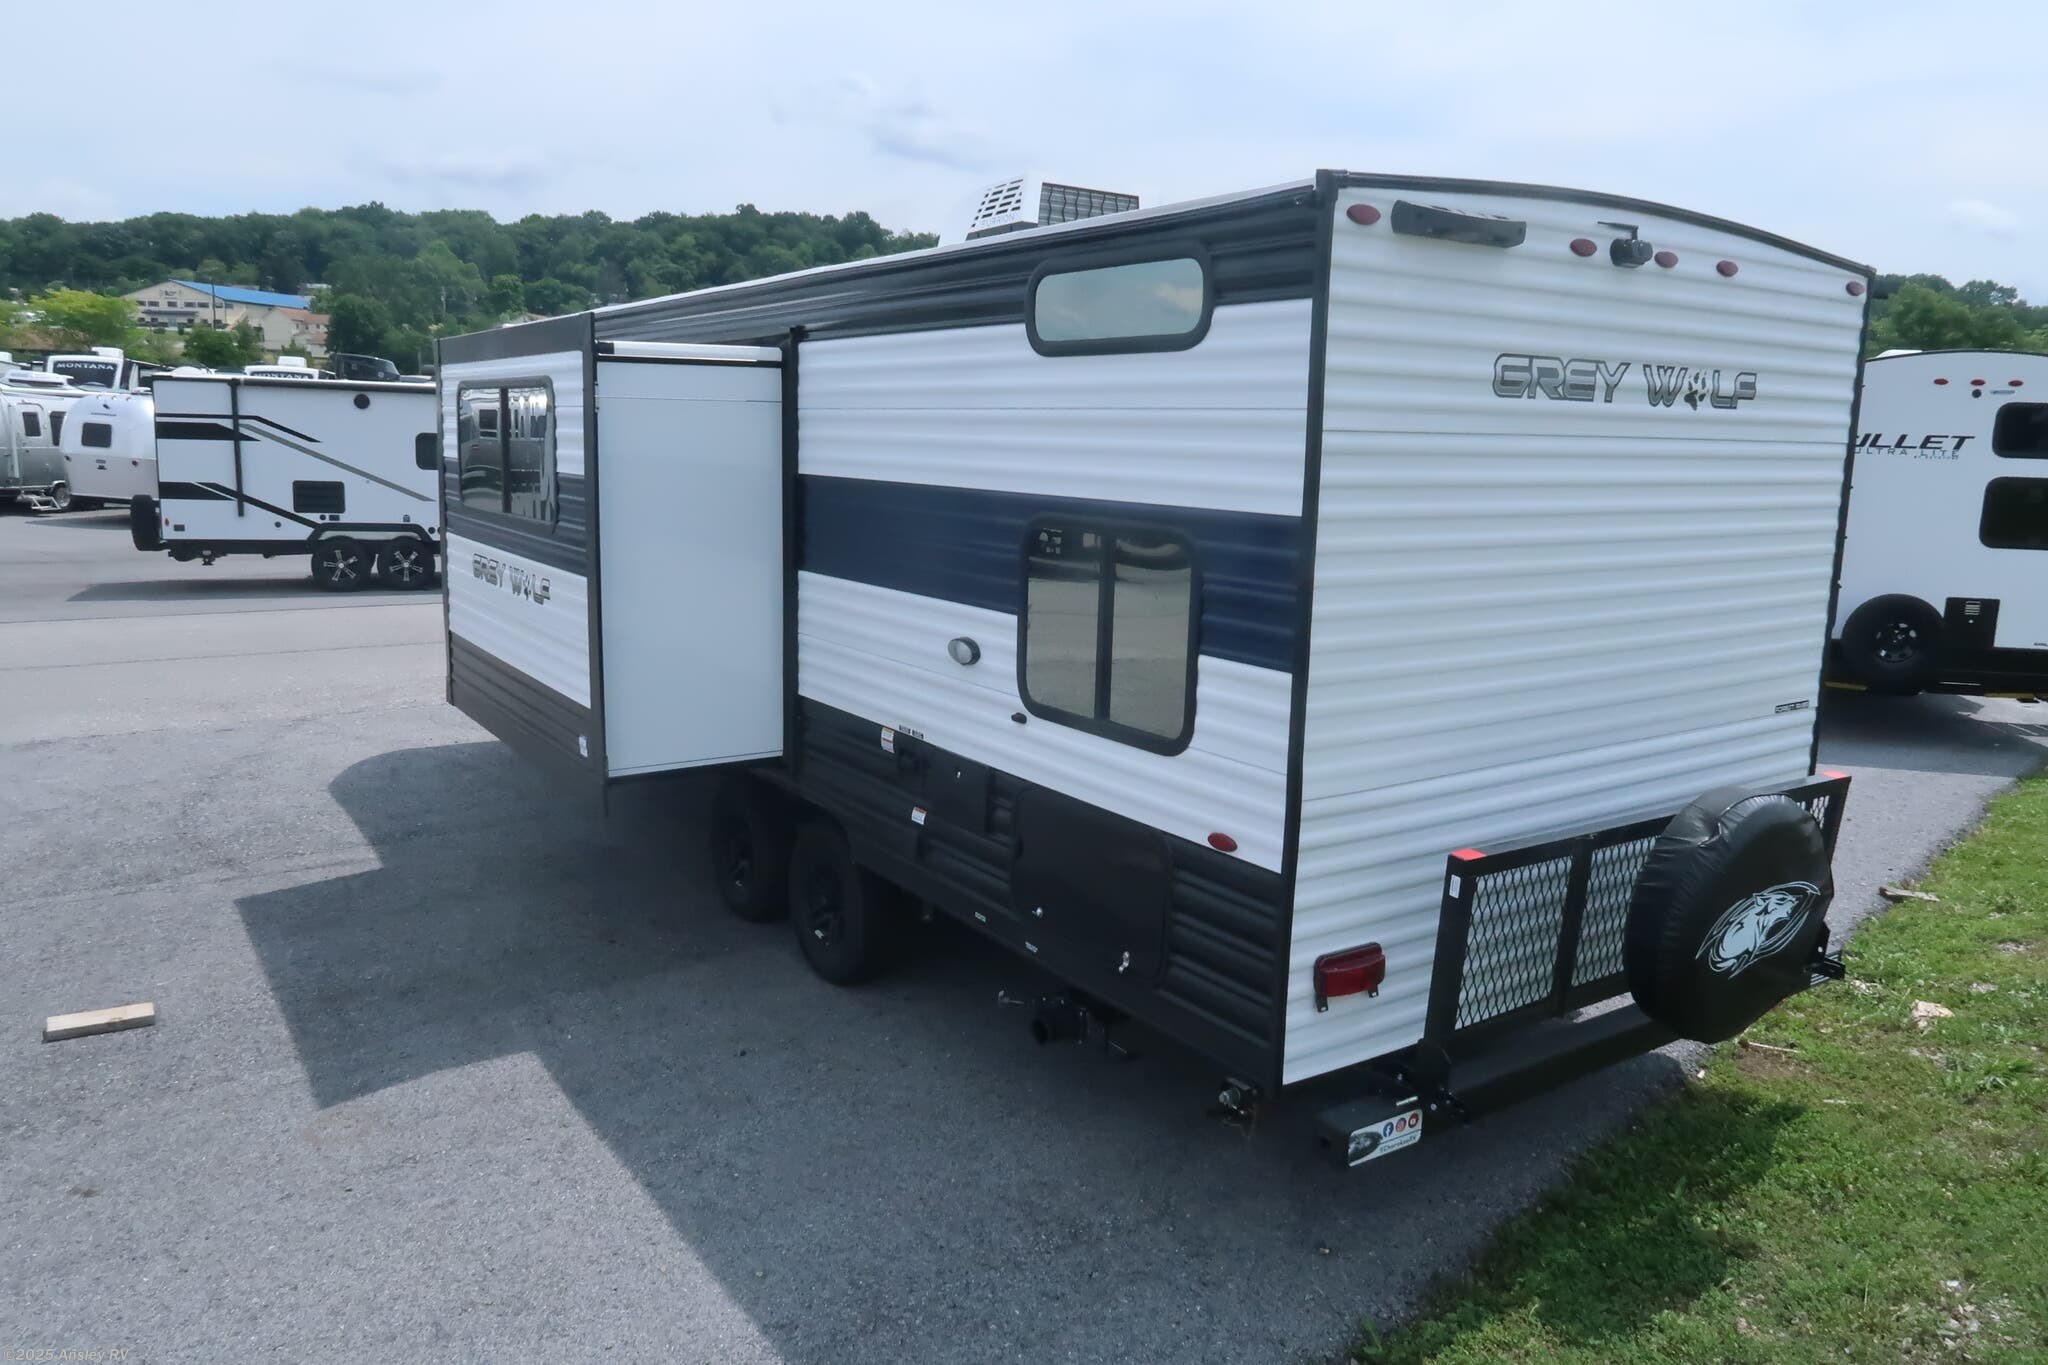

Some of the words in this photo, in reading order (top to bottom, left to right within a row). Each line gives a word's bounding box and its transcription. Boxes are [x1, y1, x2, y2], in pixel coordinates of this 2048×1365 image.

[56, 362, 114, 370] MONTANA
[1493, 353, 1631, 403] GREY
[1855, 433, 1976, 450] ULLET
[473, 553, 506, 588] GREY
